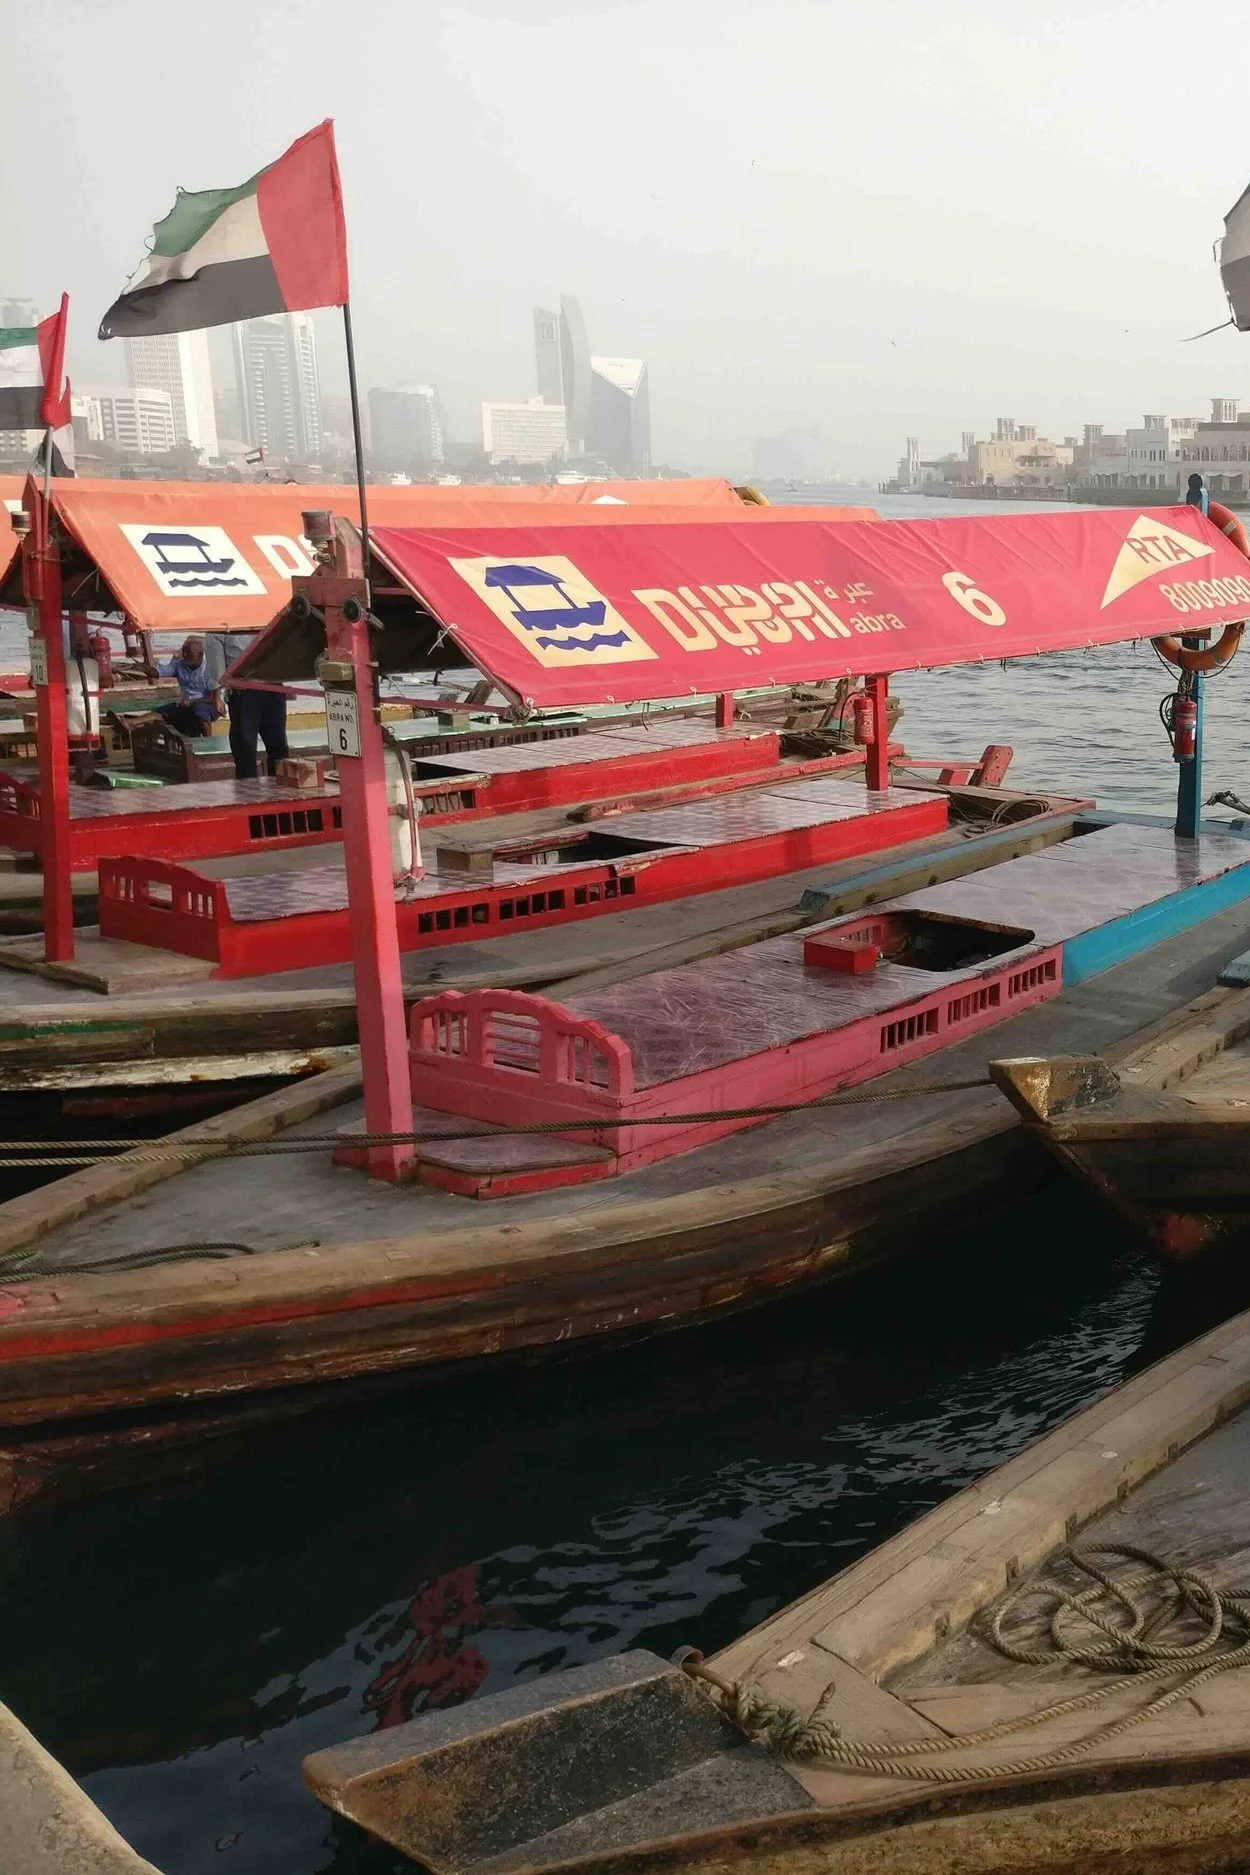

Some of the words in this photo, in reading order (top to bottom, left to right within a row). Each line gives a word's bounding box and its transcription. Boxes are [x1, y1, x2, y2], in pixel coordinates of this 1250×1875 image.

[1125, 535, 1192, 564] RTA
[941, 571, 1007, 627] 6
[849, 611, 908, 634] abra
[339, 728, 348, 751] 6
